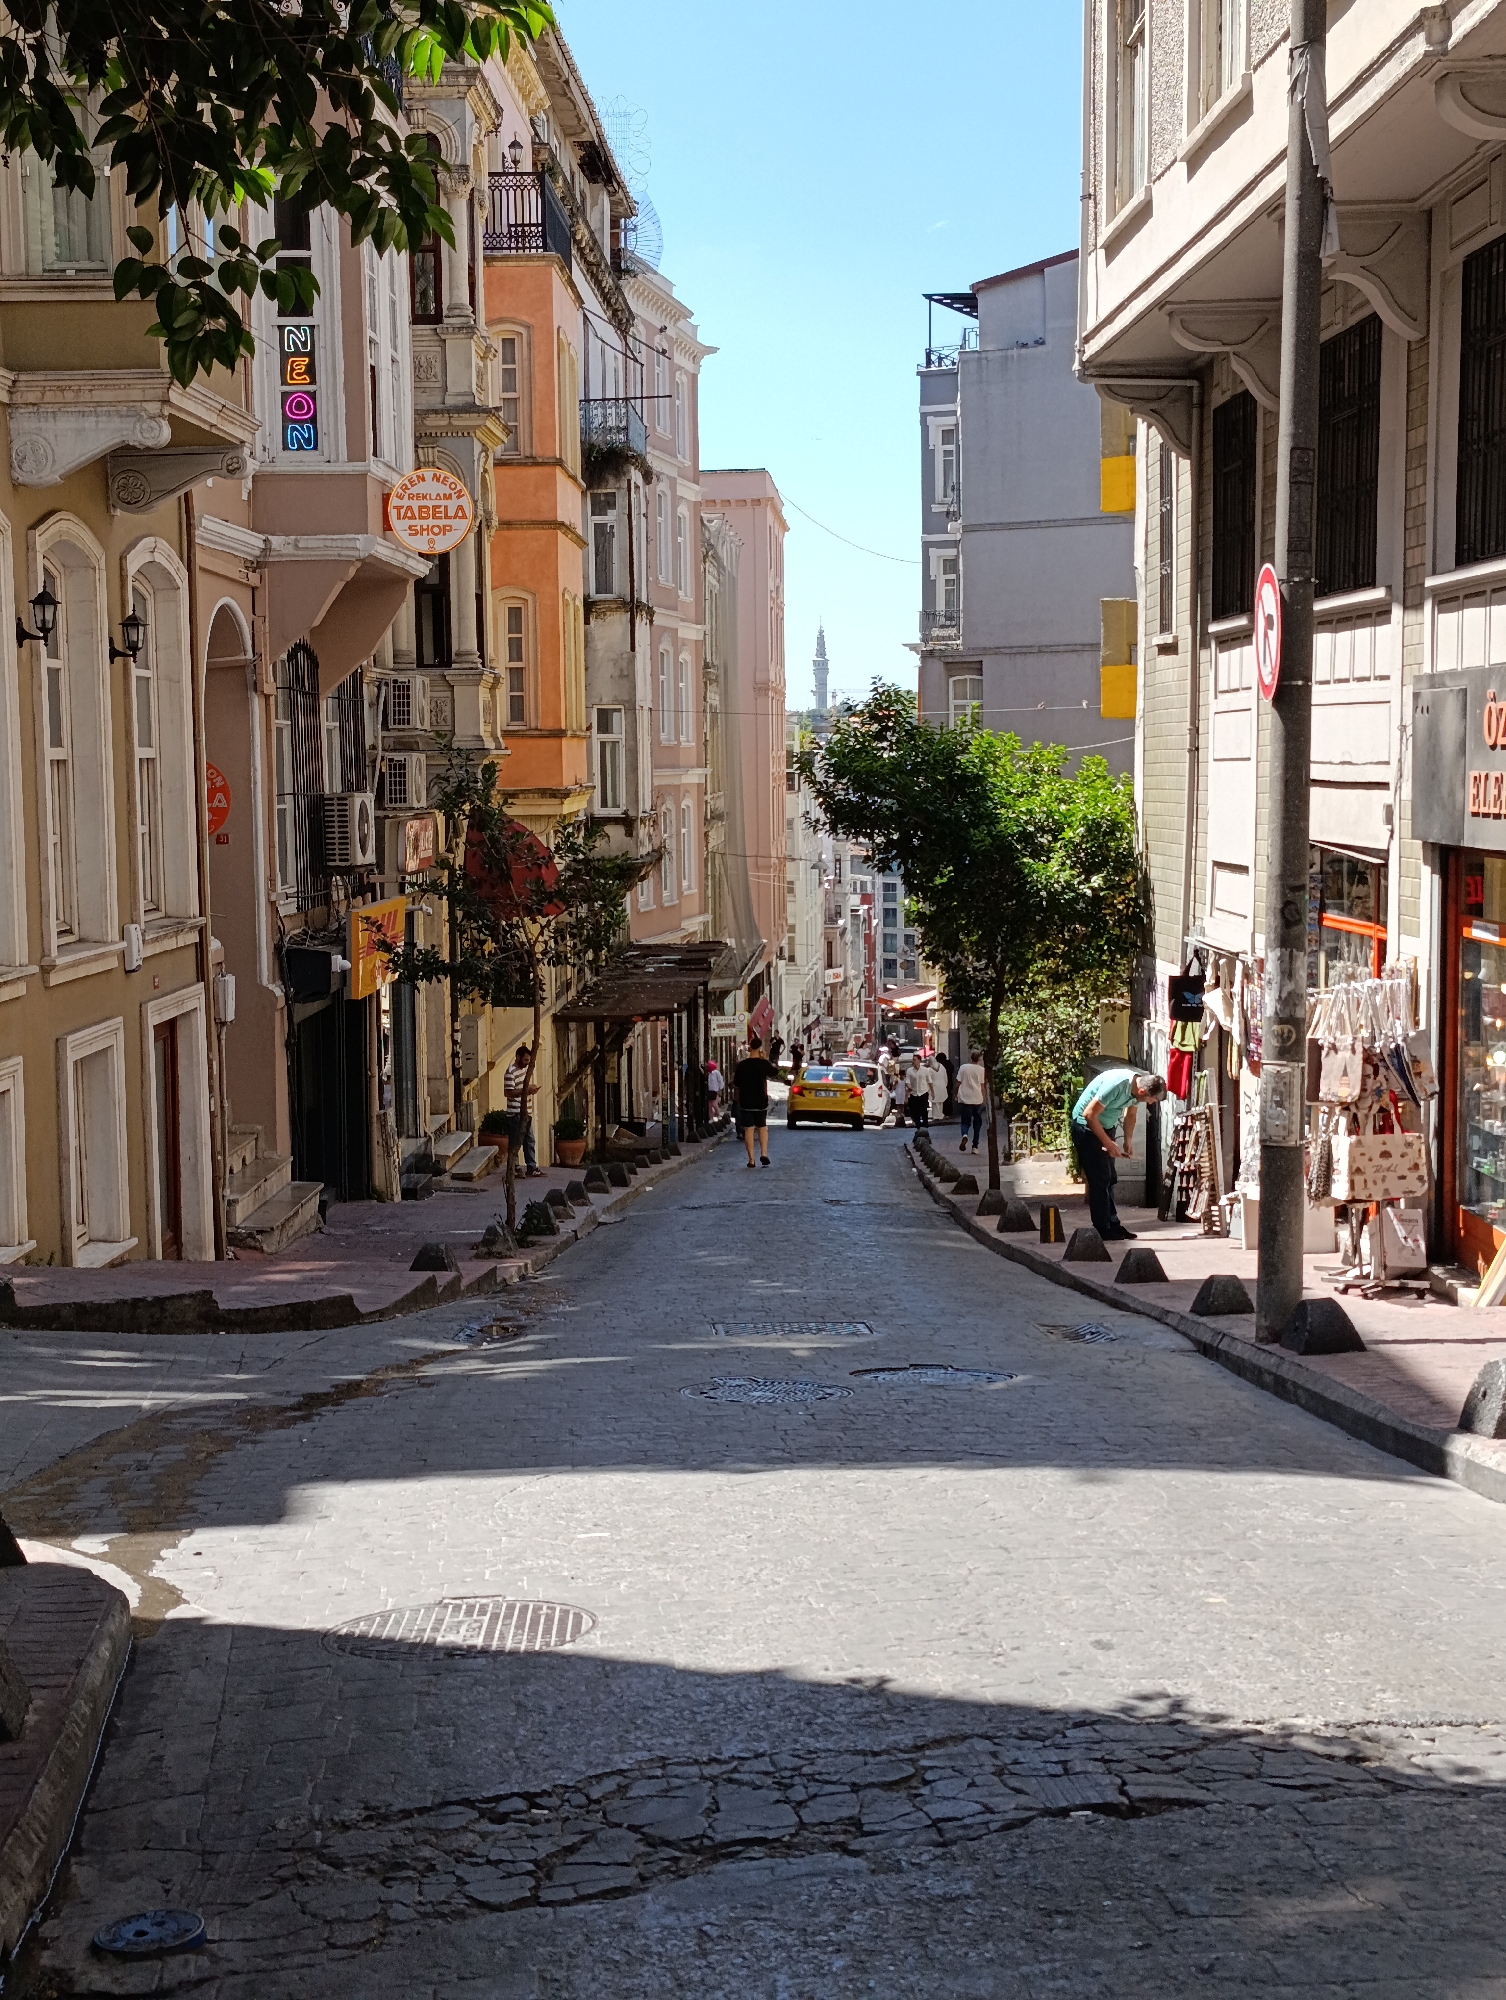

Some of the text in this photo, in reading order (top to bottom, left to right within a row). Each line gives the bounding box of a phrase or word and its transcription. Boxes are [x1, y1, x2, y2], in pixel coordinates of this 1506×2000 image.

[284, 326, 314, 450] NEON
[395, 472, 466, 501] EREN NEON
[407, 492, 453, 501] REKLAM
[392, 504, 469, 521] TABELA
[407, 524, 453, 537] SHOP
[1468, 770, 1506, 815] ELE
